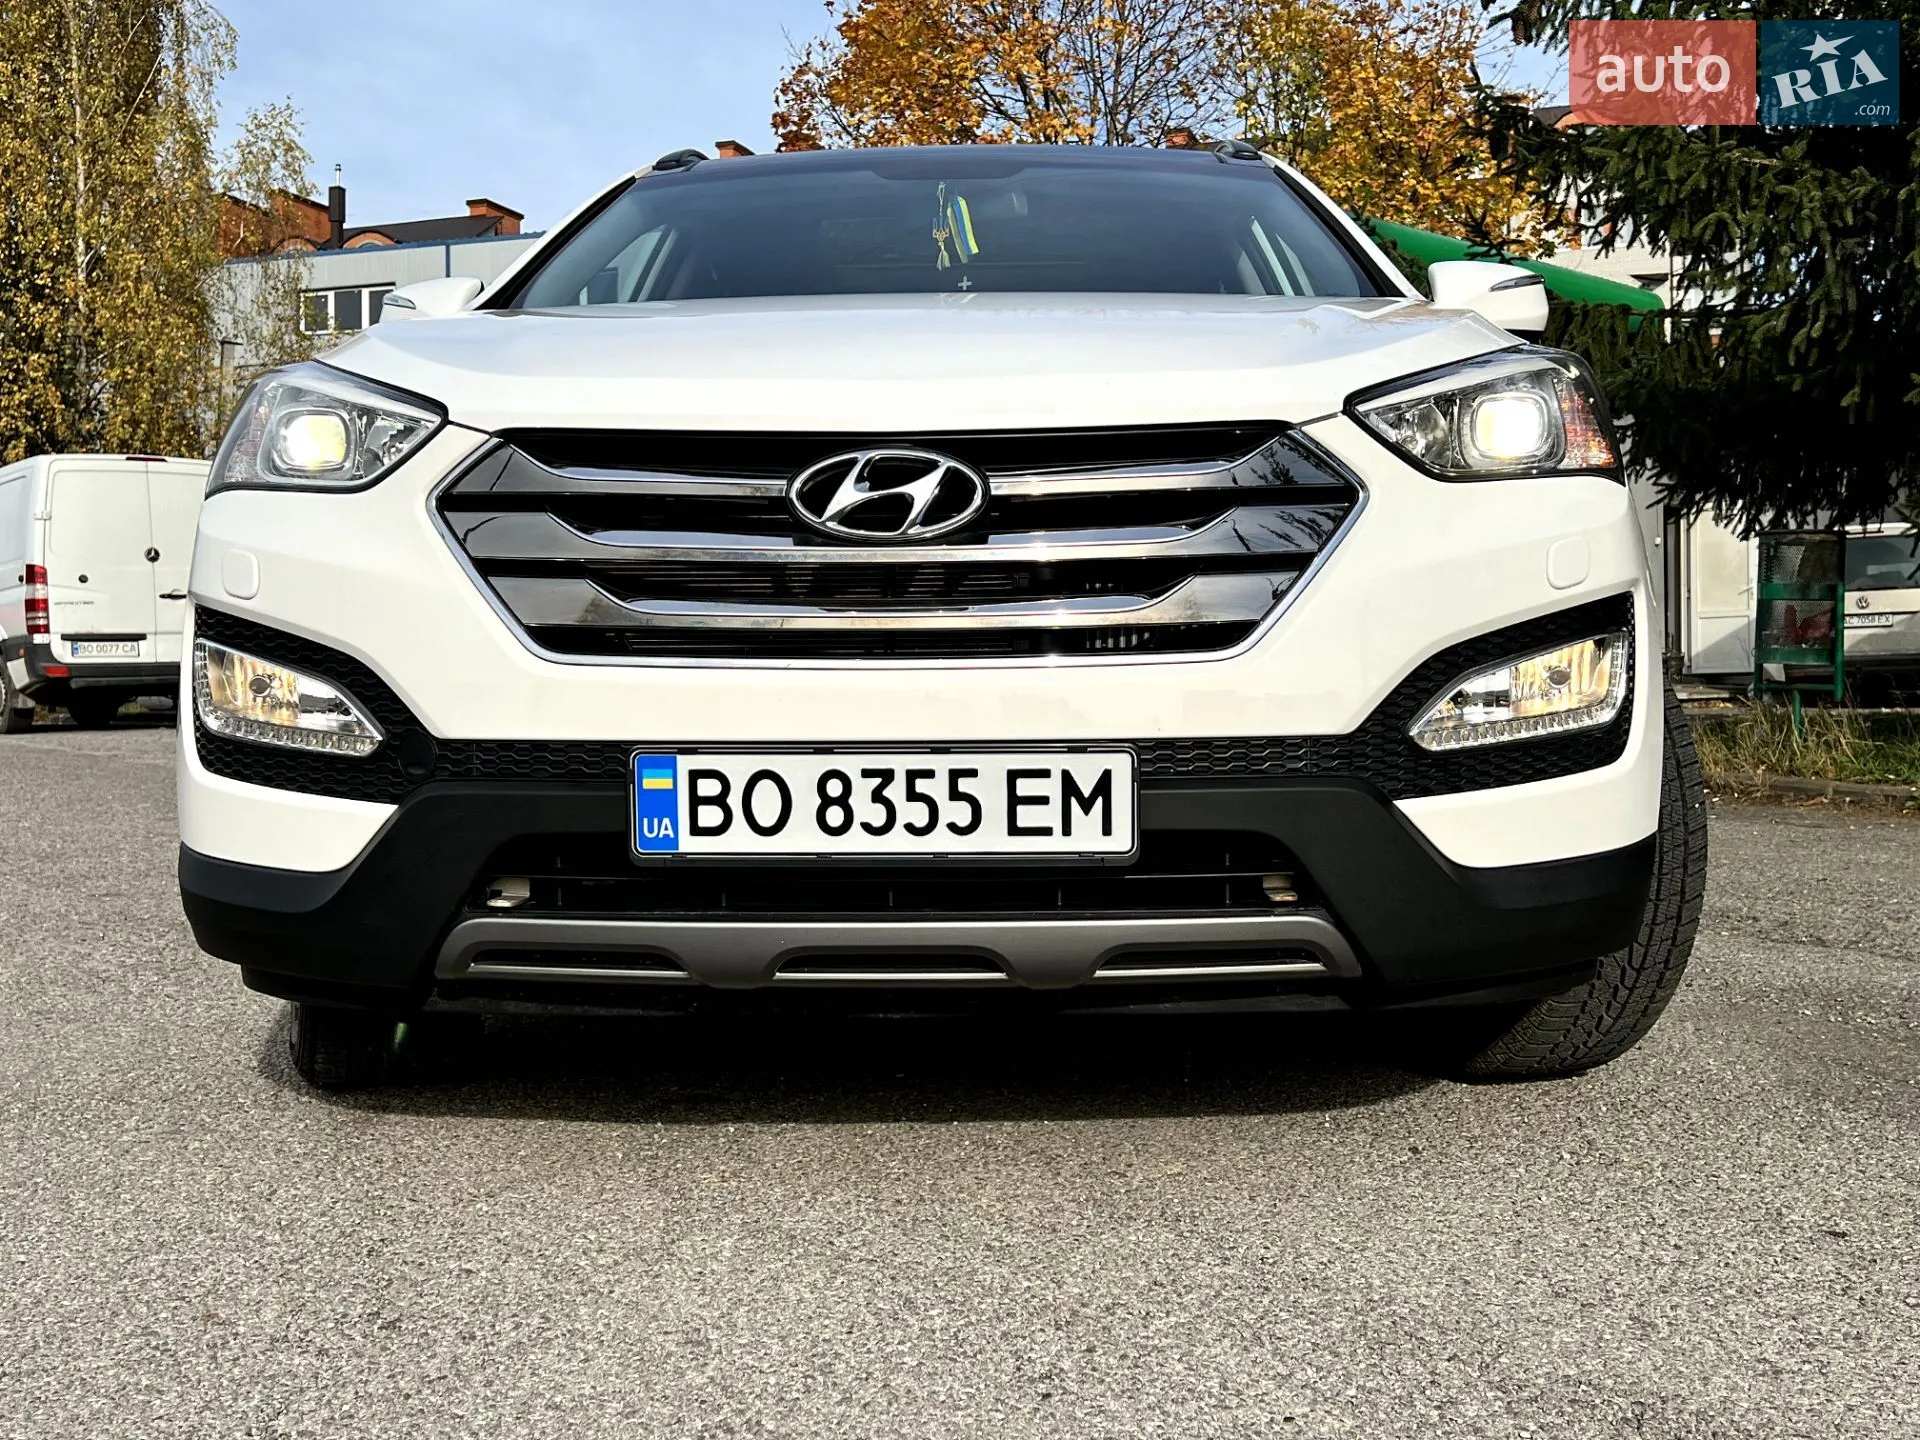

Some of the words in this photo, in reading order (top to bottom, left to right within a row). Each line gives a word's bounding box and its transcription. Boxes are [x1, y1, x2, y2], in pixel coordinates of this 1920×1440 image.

[1878, 614, 1890, 623] EX
[79, 643, 94, 653] BO
[96, 643, 118, 653] 0077
[121, 643, 136, 653] CA
[688, 768, 793, 837] BO
[815, 768, 983, 837] 8355
[1006, 768, 1113, 837] EM
[643, 817, 675, 839] UA
